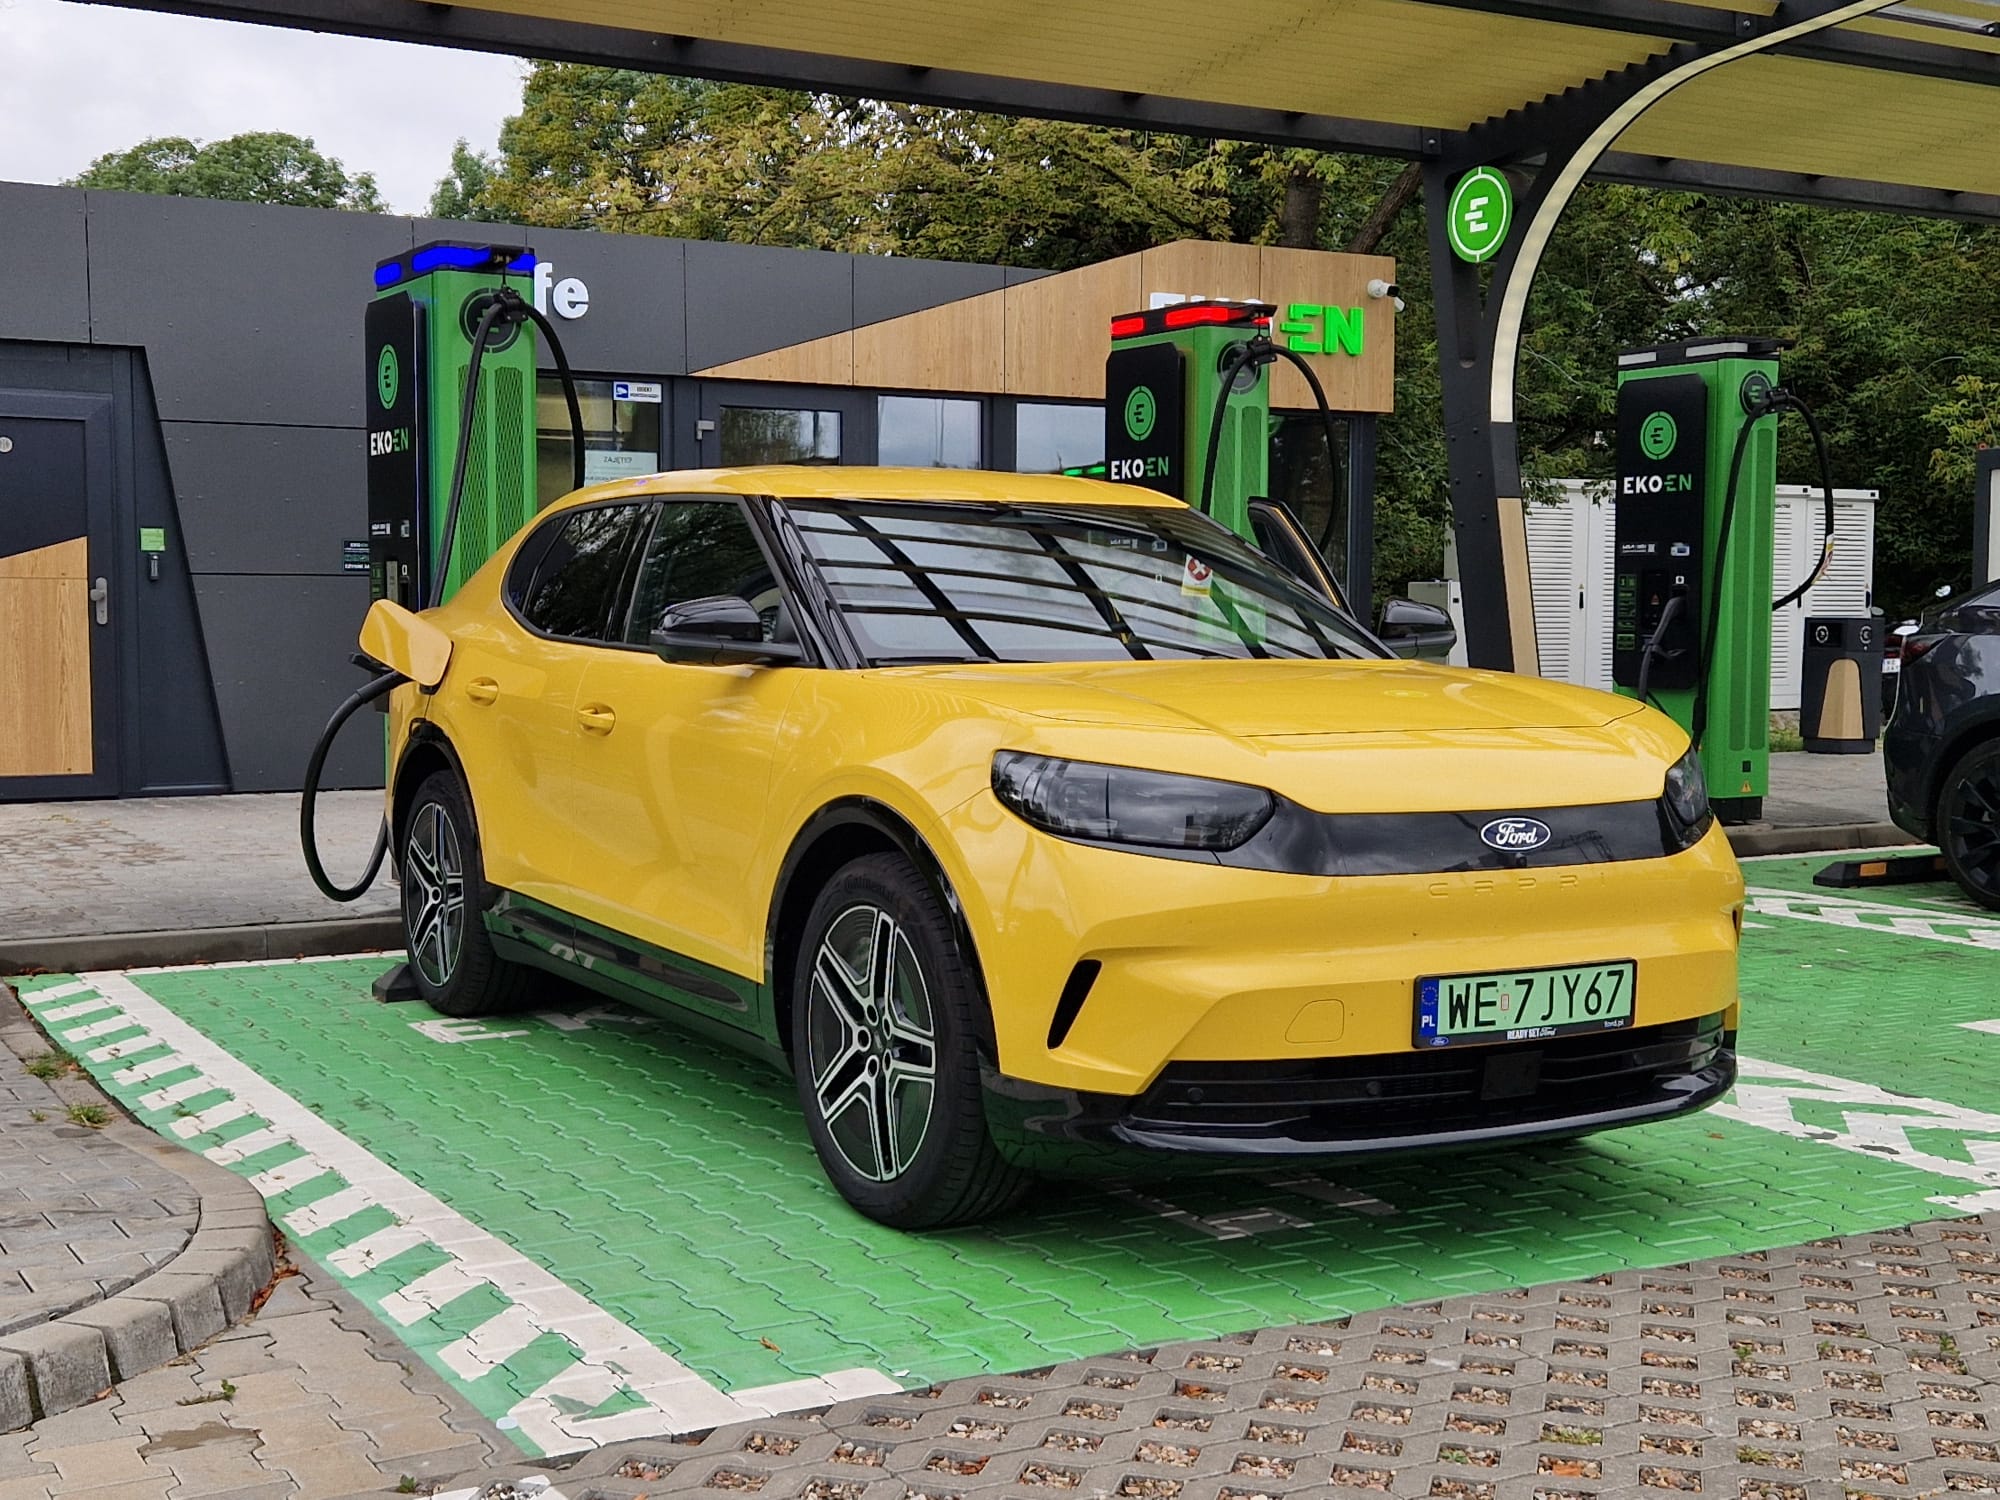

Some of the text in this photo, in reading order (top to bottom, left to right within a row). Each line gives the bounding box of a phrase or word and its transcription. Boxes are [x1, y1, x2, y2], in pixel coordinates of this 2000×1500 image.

[370, 427, 409, 456] EKOEN
[1111, 456, 1169, 480] EKOEN
[1623, 473, 1692, 495] EKOEN
[1496, 822, 1538, 845] Ford
[1448, 969, 1625, 1030] WE 7JY67
[1421, 1015, 1436, 1028] PL
